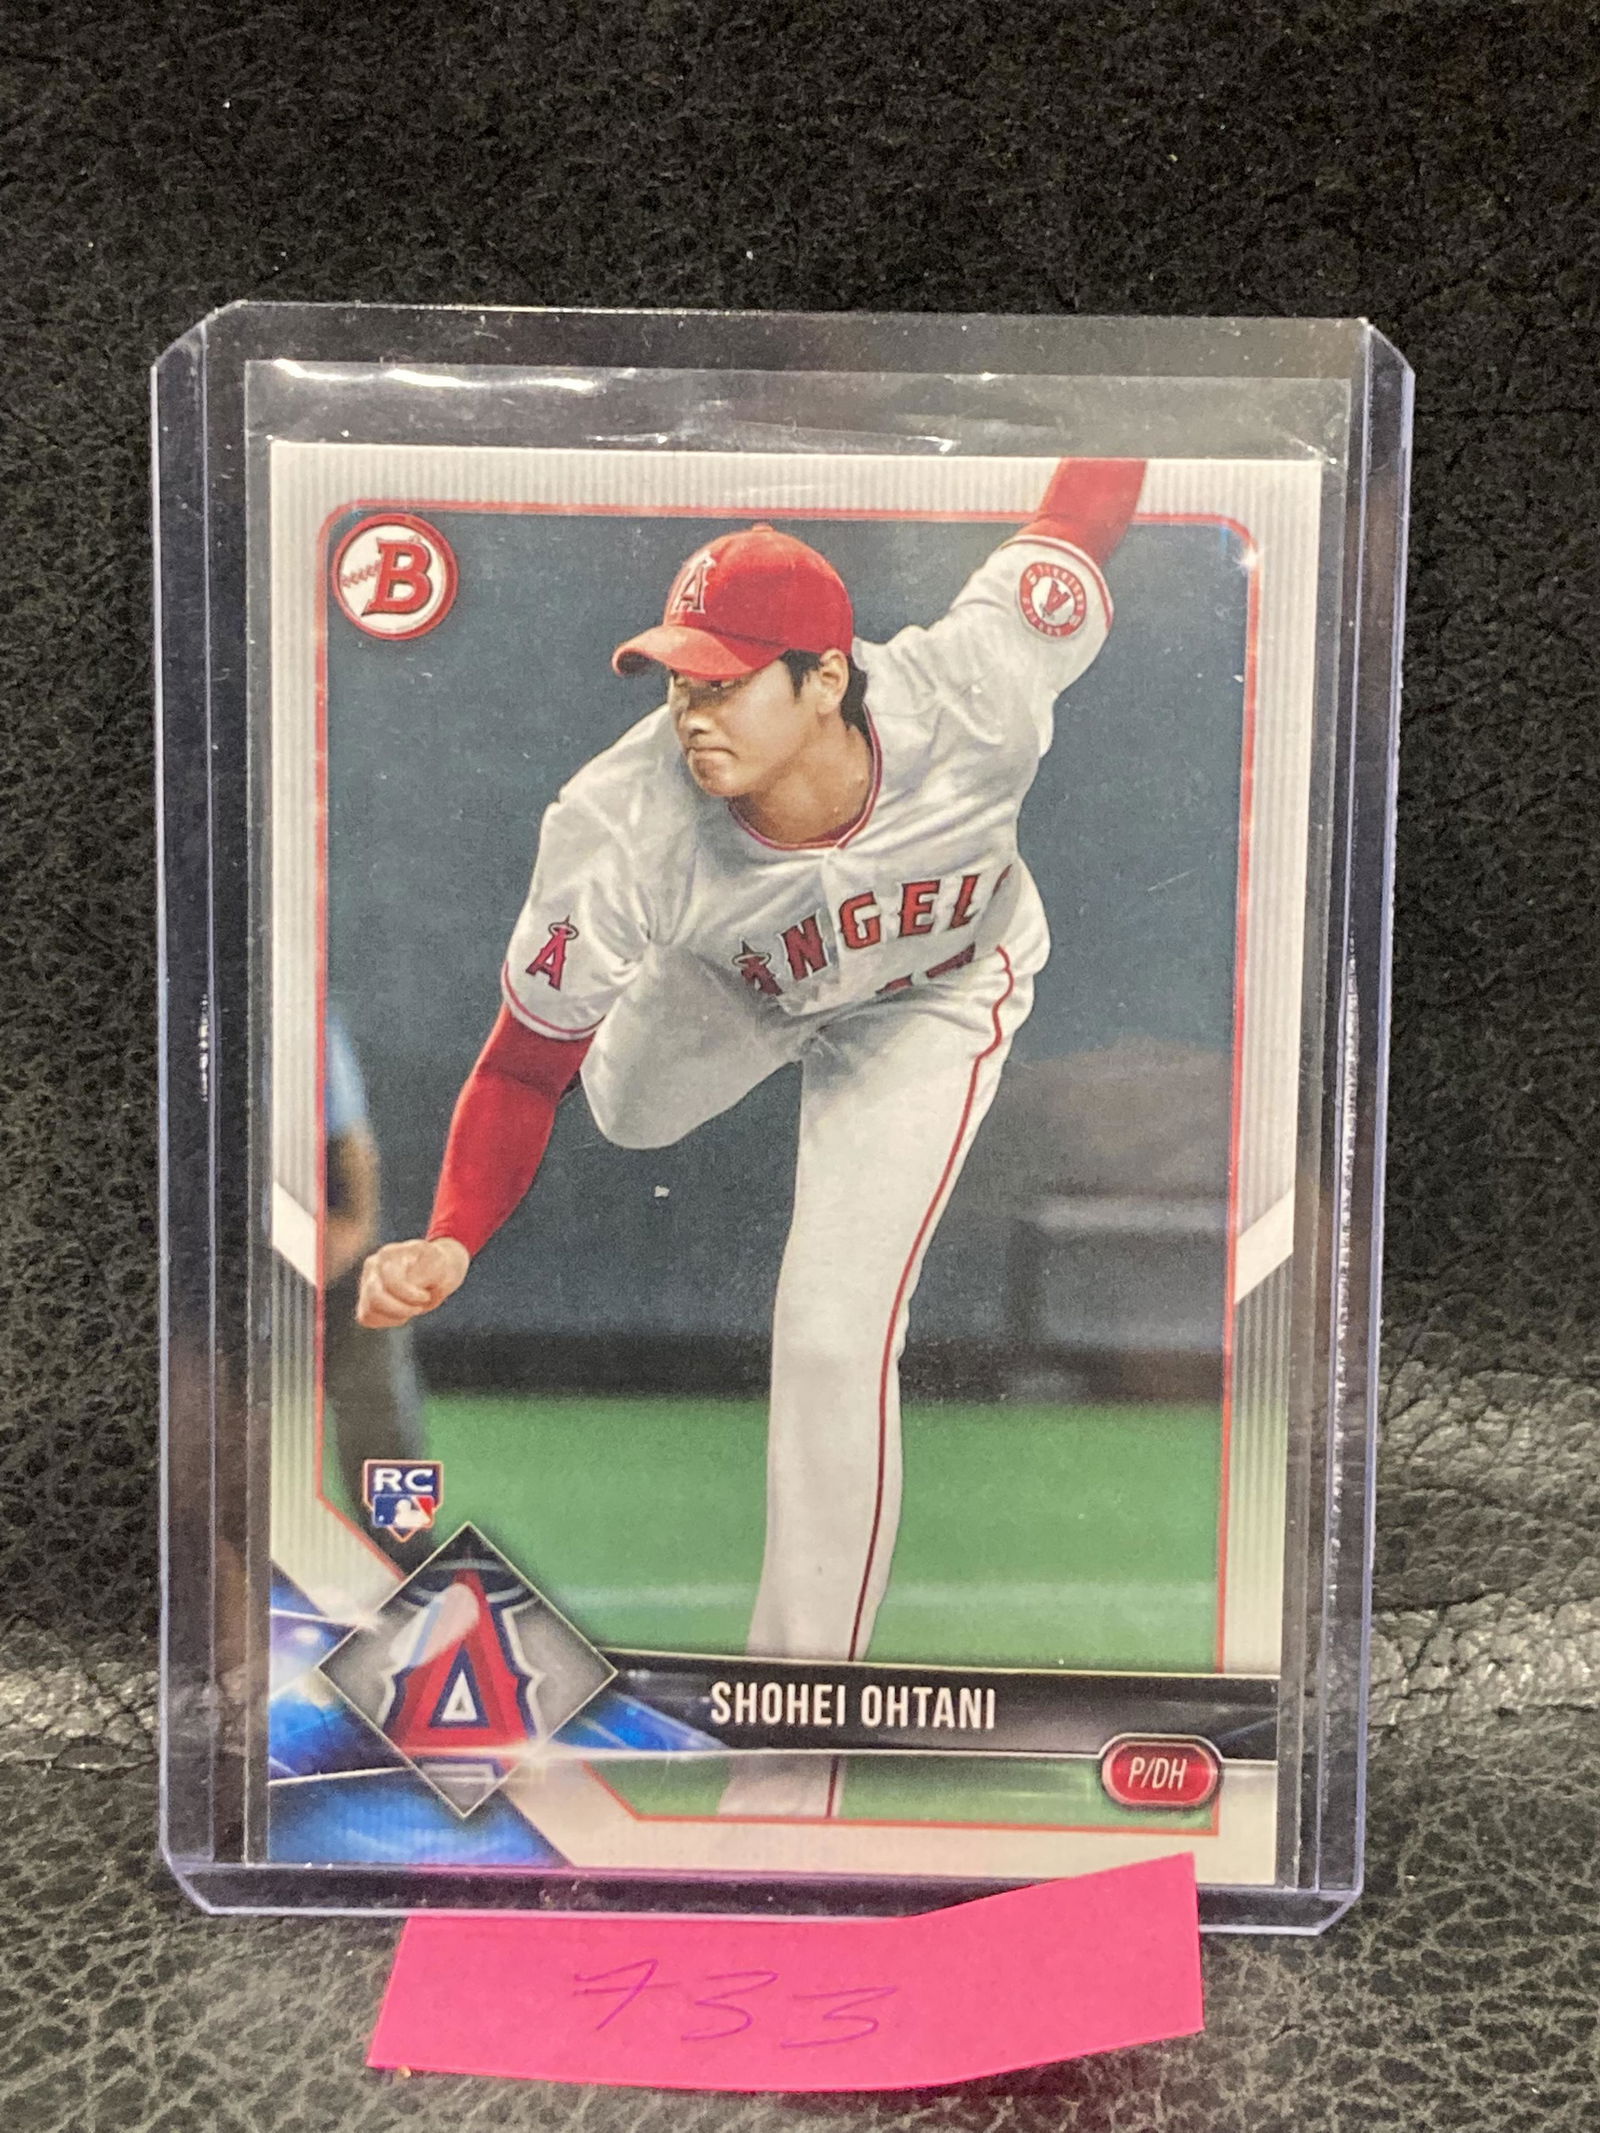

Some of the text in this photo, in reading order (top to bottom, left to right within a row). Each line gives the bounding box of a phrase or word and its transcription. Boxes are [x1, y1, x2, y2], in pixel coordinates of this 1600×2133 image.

[361, 538, 433, 617] B
[671, 550, 717, 615] A
[525, 915, 579, 991] A
[731, 864, 1013, 997] ANGEL
[374, 1468, 434, 1492] RC
[710, 1681, 996, 1730] SHOHEI OHTANI
[1127, 1756, 1188, 1790] P/DH
[572, 1957, 898, 2049] 733
